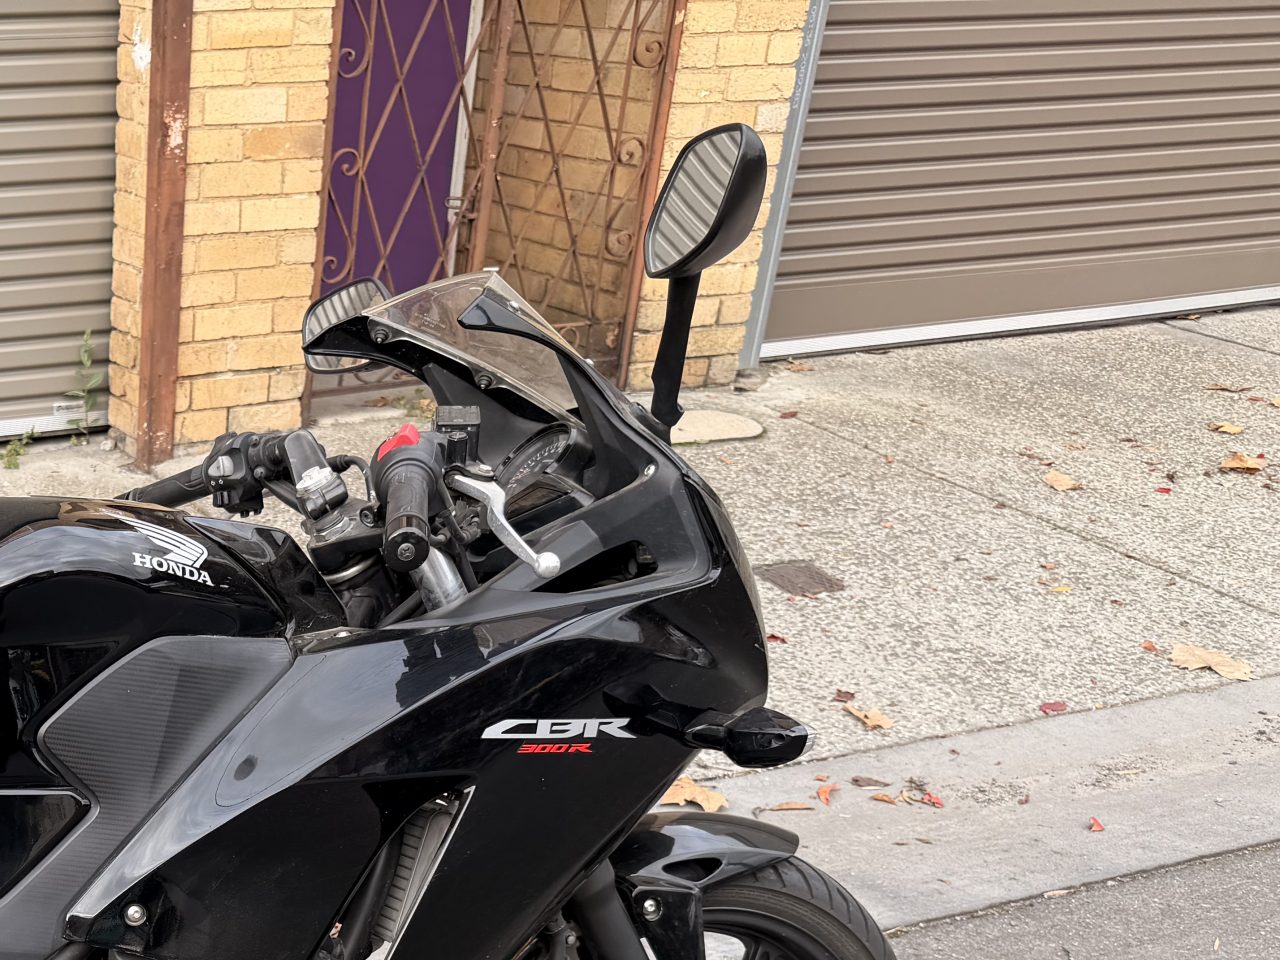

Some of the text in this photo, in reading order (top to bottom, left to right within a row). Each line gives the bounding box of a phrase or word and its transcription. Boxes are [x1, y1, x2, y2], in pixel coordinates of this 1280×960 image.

[132, 552, 214, 587] HONDA
[480, 718, 637, 739] CBR
[517, 743, 592, 753] 300R
